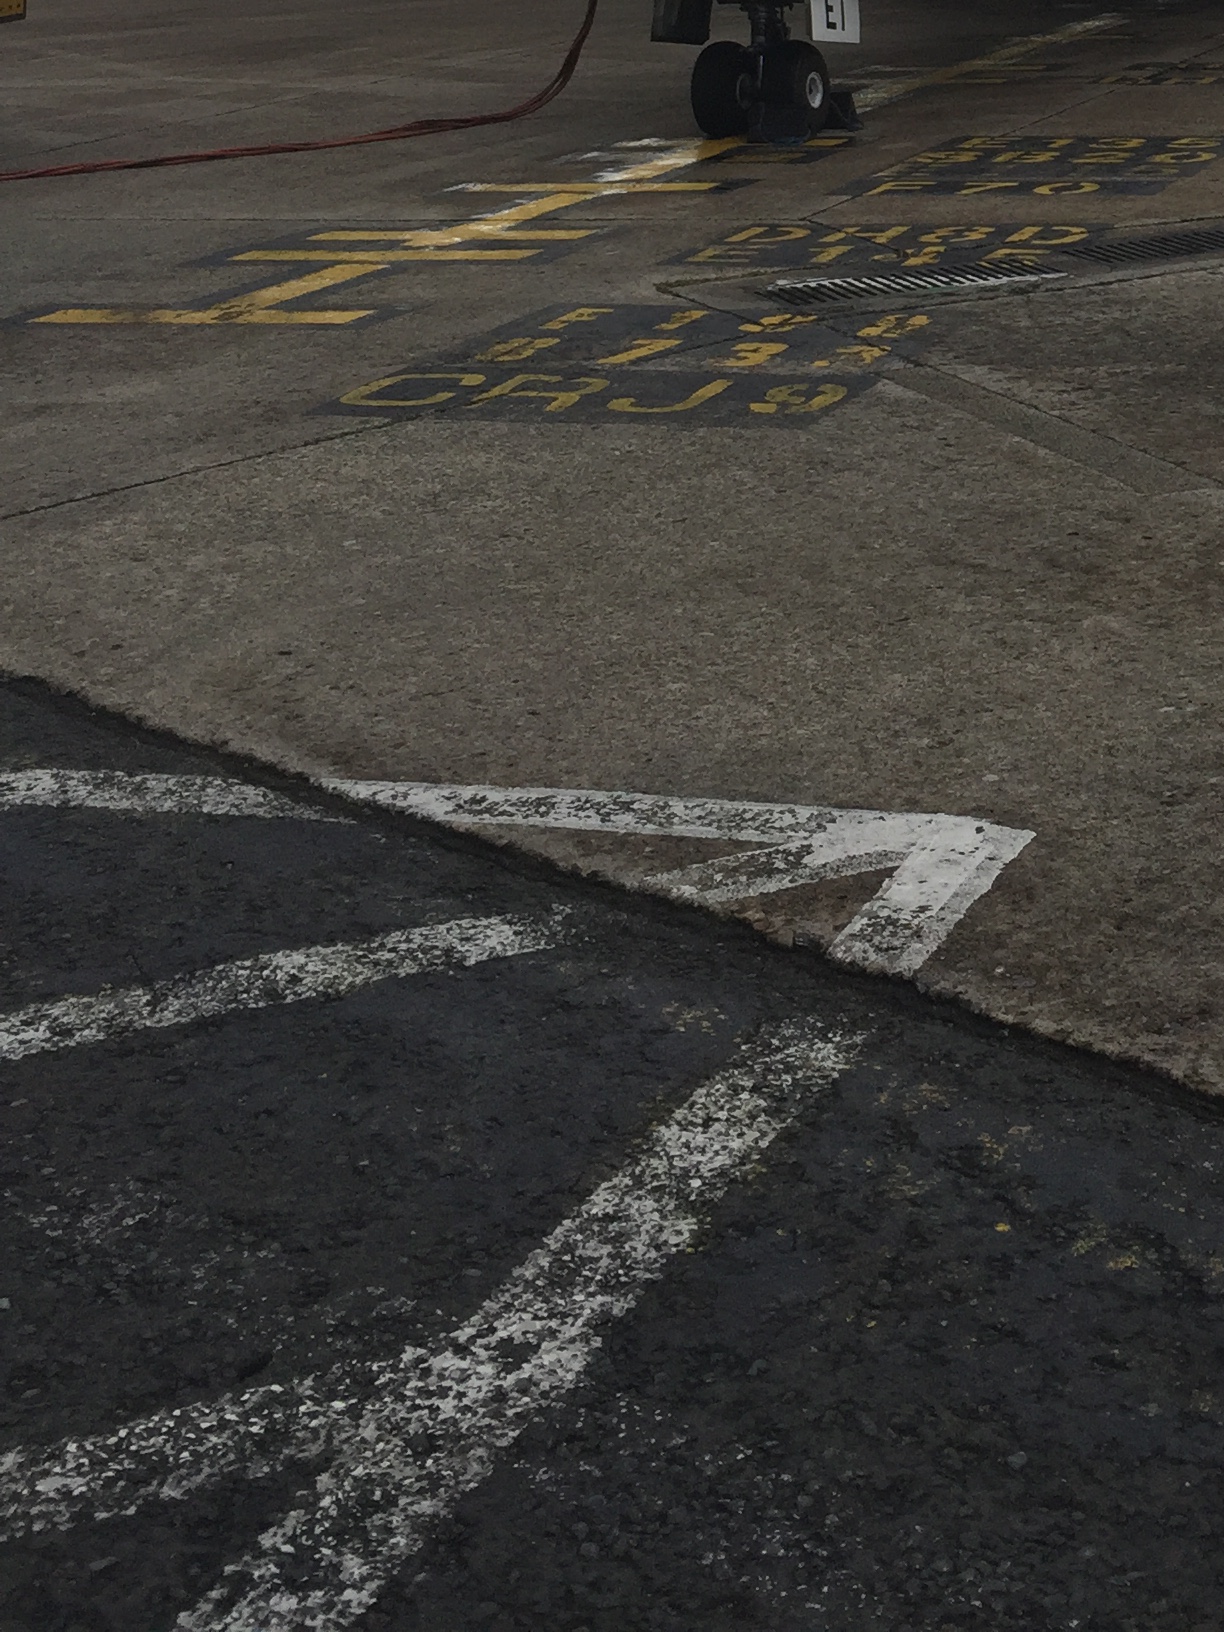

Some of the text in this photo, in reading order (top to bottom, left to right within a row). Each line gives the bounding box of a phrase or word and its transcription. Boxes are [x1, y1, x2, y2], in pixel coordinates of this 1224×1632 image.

[957, 136, 1223, 150] E135
[863, 180, 1102, 197] F70
[723, 225, 1090, 245] DH8D
